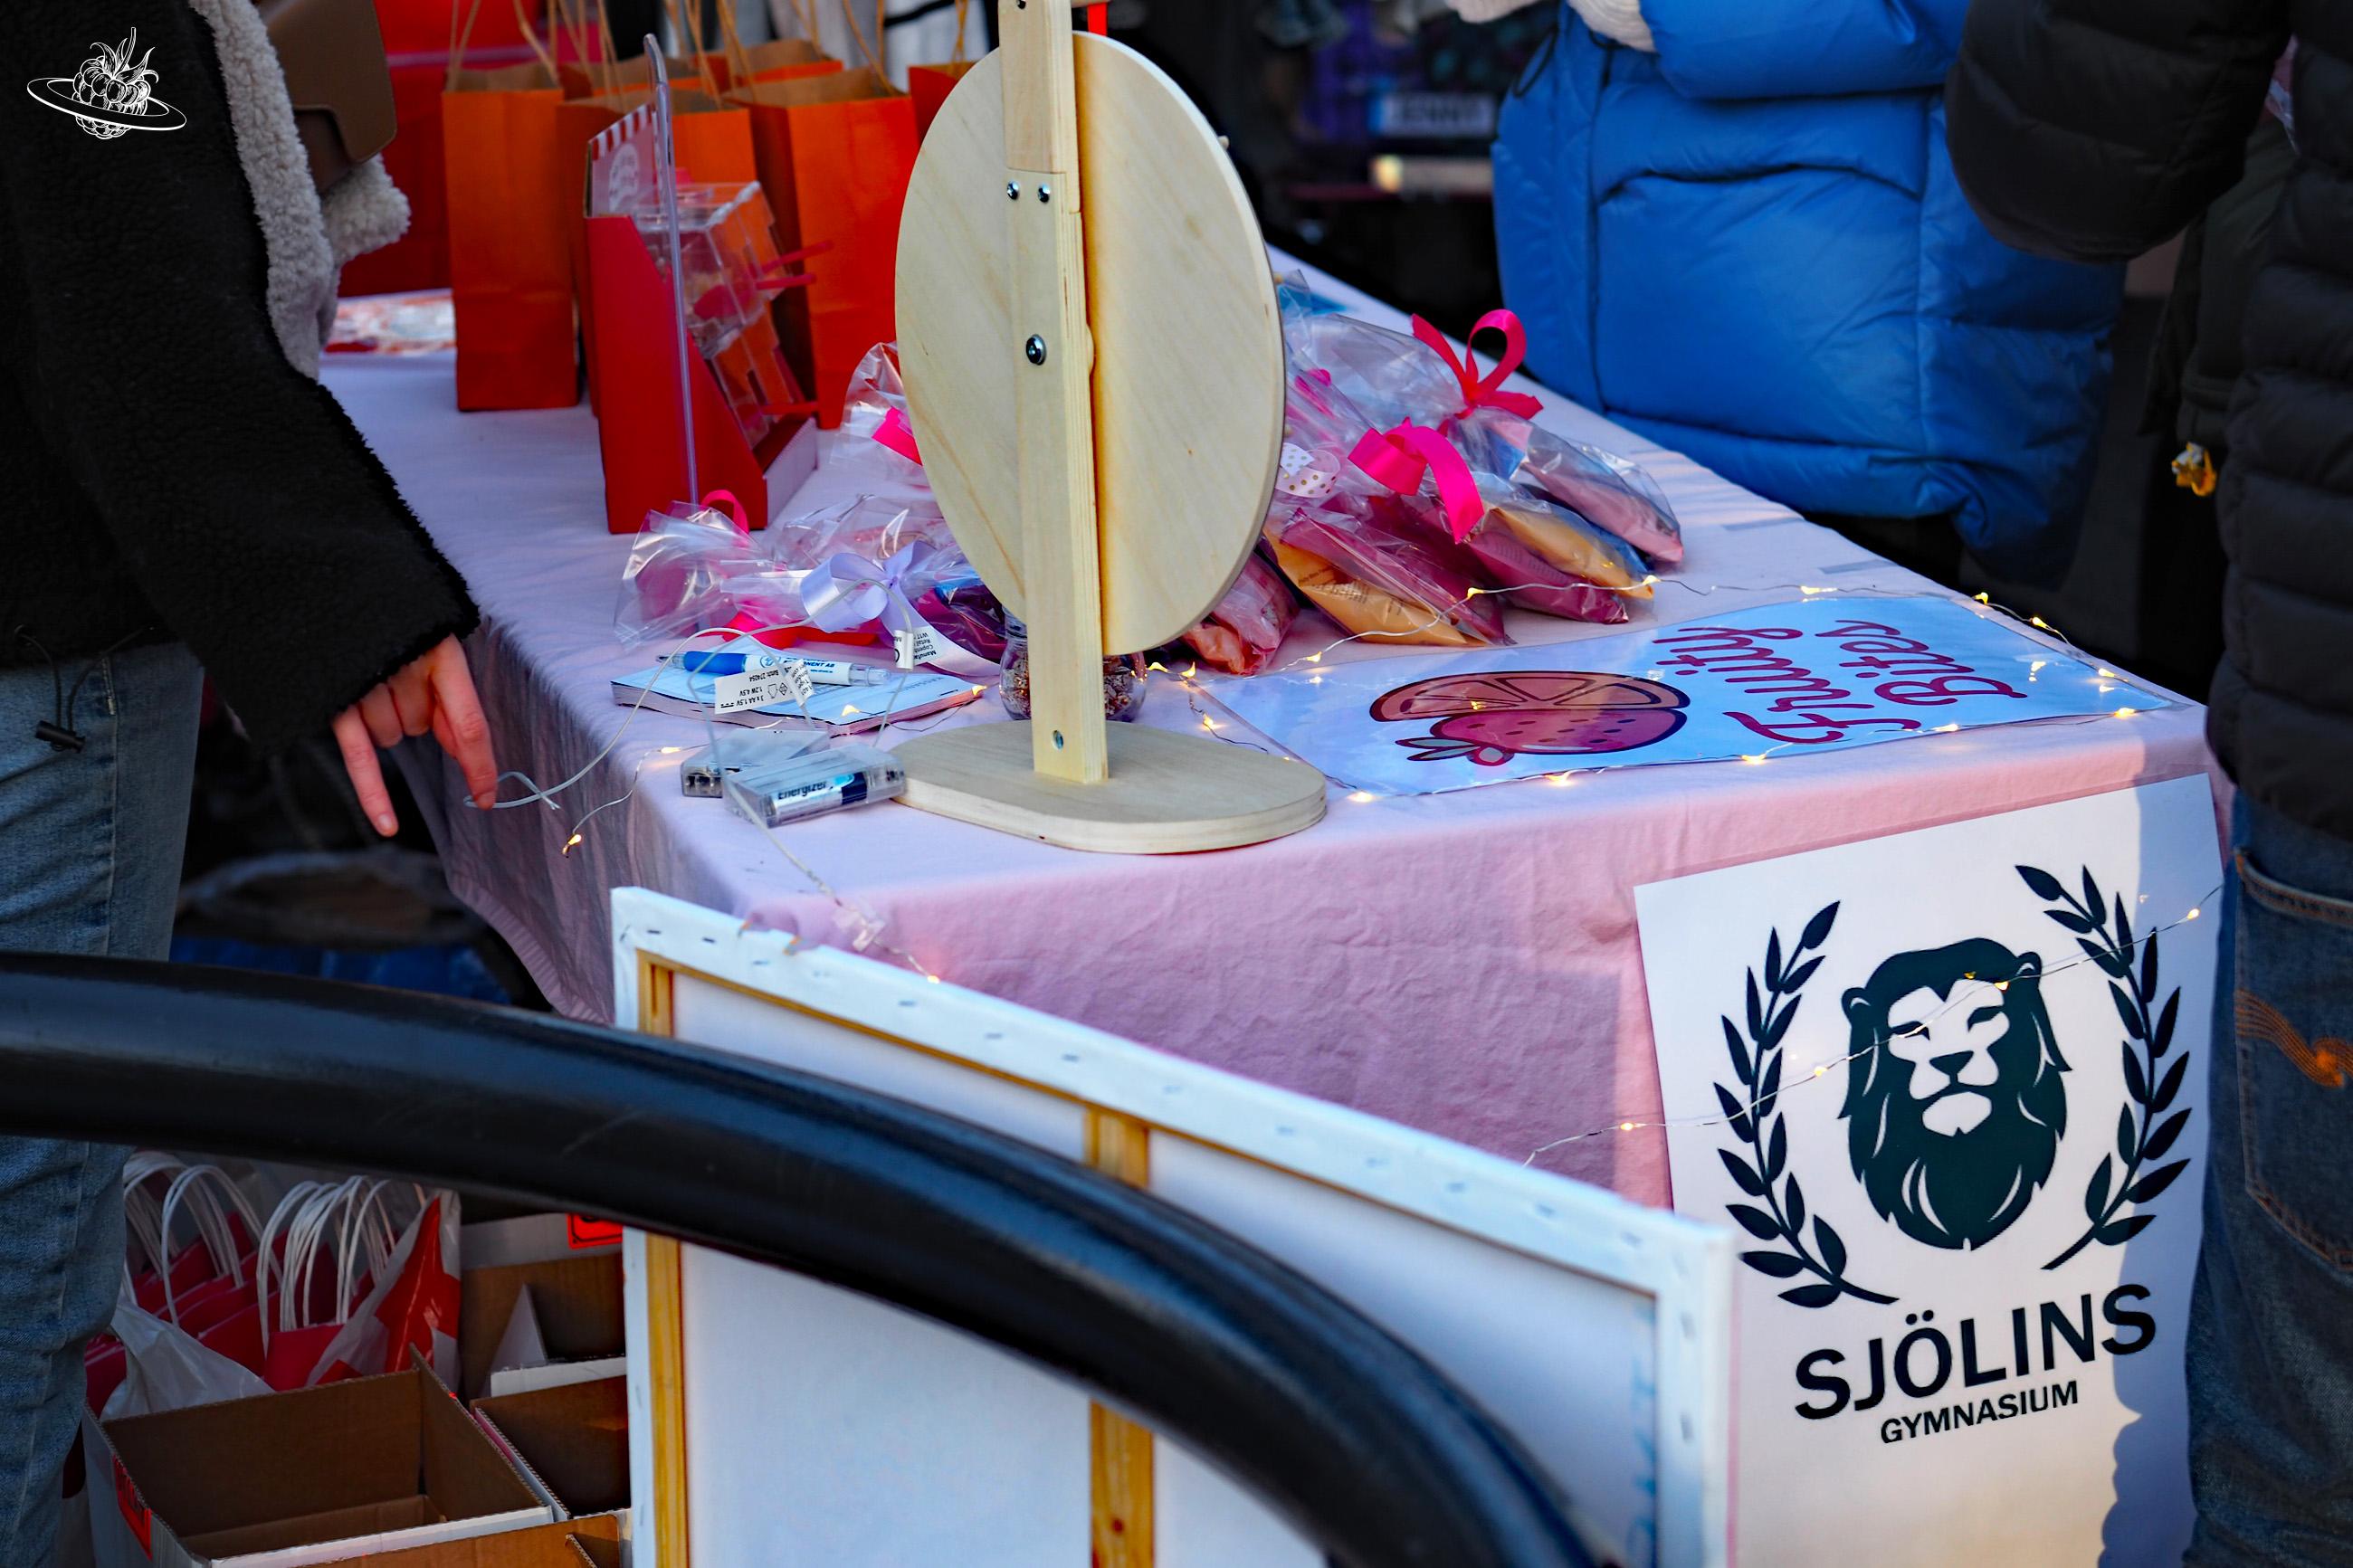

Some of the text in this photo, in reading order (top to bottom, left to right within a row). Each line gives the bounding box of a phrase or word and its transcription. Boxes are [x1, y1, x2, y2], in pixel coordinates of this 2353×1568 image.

[913, 650, 937, 660] Manufa
[1652, 626, 1922, 745] Fruity
[1814, 618, 2028, 707] Bites
[777, 781, 827, 800] Energizer
[1794, 1283, 2158, 1421] SJÖLINS
[1880, 1380, 2079, 1445] GYMNASIUM
